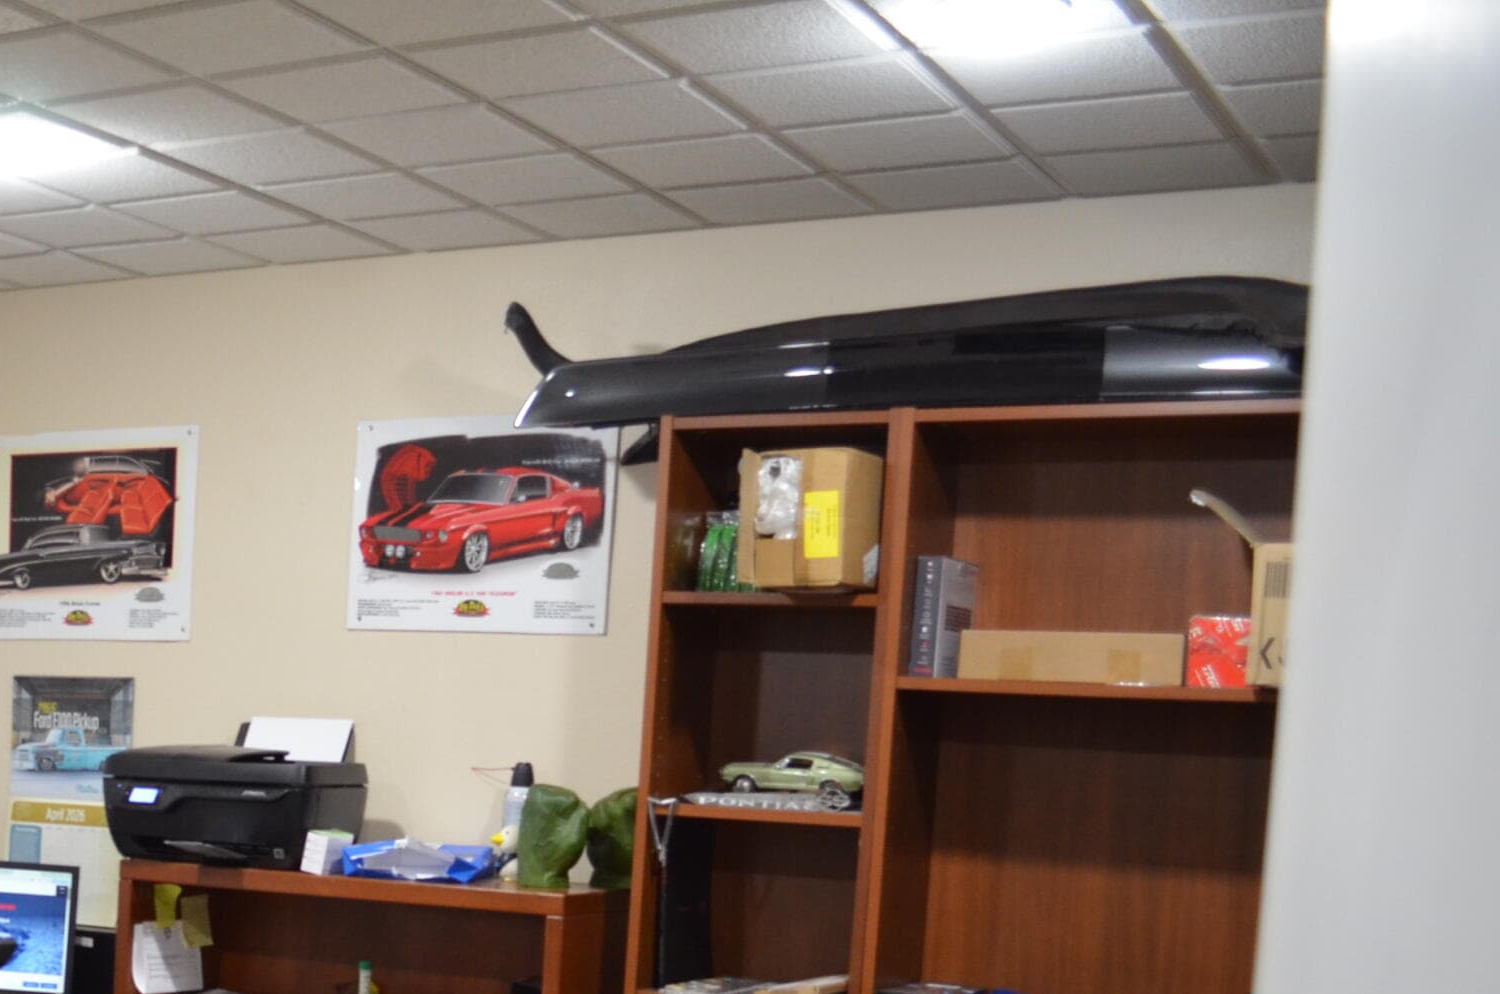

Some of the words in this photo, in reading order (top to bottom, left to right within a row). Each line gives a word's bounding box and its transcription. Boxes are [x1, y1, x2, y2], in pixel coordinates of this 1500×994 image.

[33, 711, 52, 729] Ford
[73, 712, 100, 732] Pickup
[46, 807, 65, 822] April
